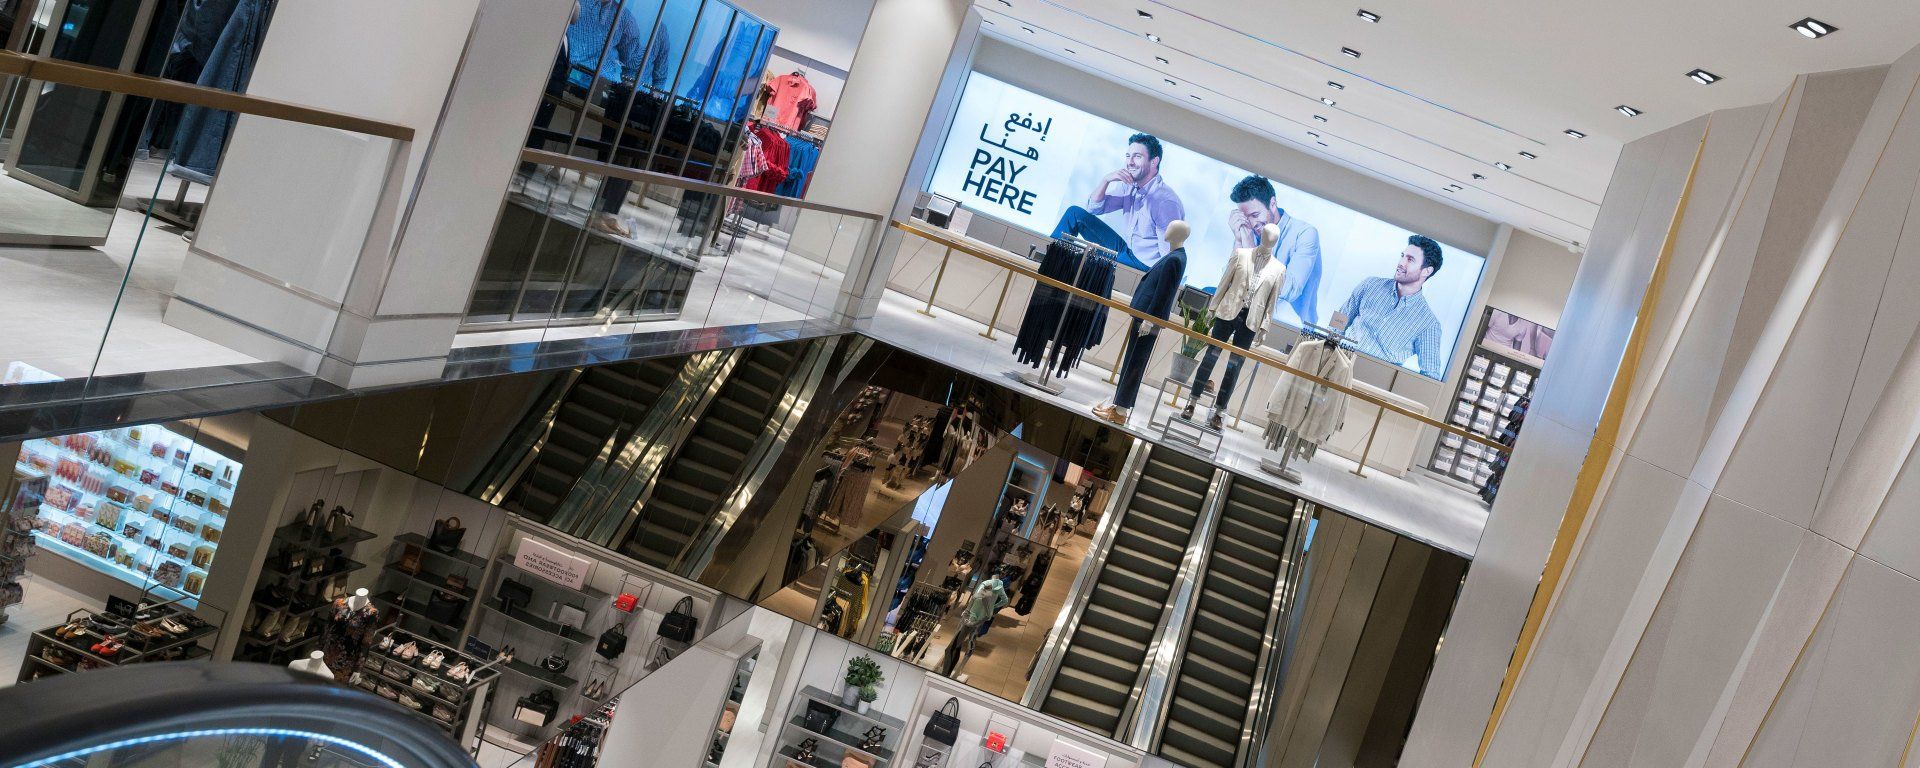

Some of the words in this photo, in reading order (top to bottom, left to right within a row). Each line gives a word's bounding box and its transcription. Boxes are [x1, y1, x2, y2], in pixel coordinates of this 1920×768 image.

[1004, 112, 1052, 142] إدفع
[970, 148, 1028, 184] PAY
[962, 170, 1037, 215] HERE
